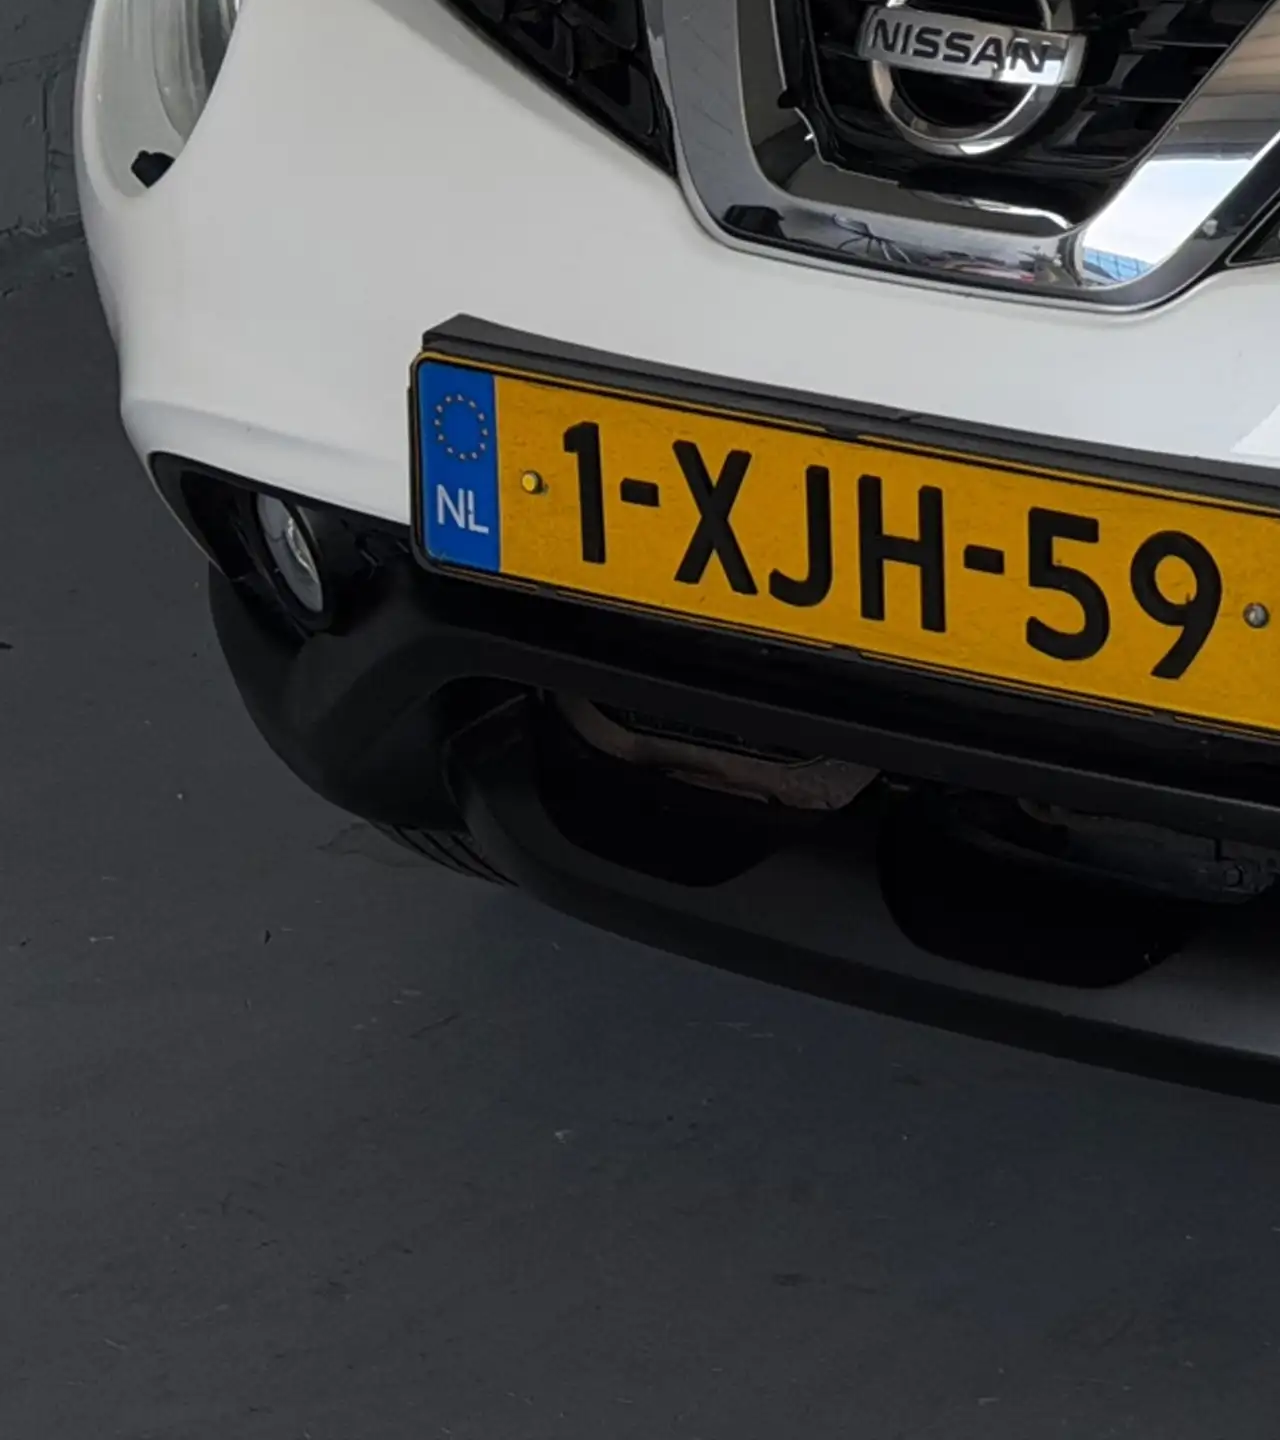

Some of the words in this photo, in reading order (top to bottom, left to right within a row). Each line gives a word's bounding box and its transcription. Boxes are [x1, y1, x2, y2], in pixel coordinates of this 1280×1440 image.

[871, 18, 1051, 73] NISSAN
[437, 484, 489, 534] NL
[562, 420, 1222, 679] 1-XJH-59
